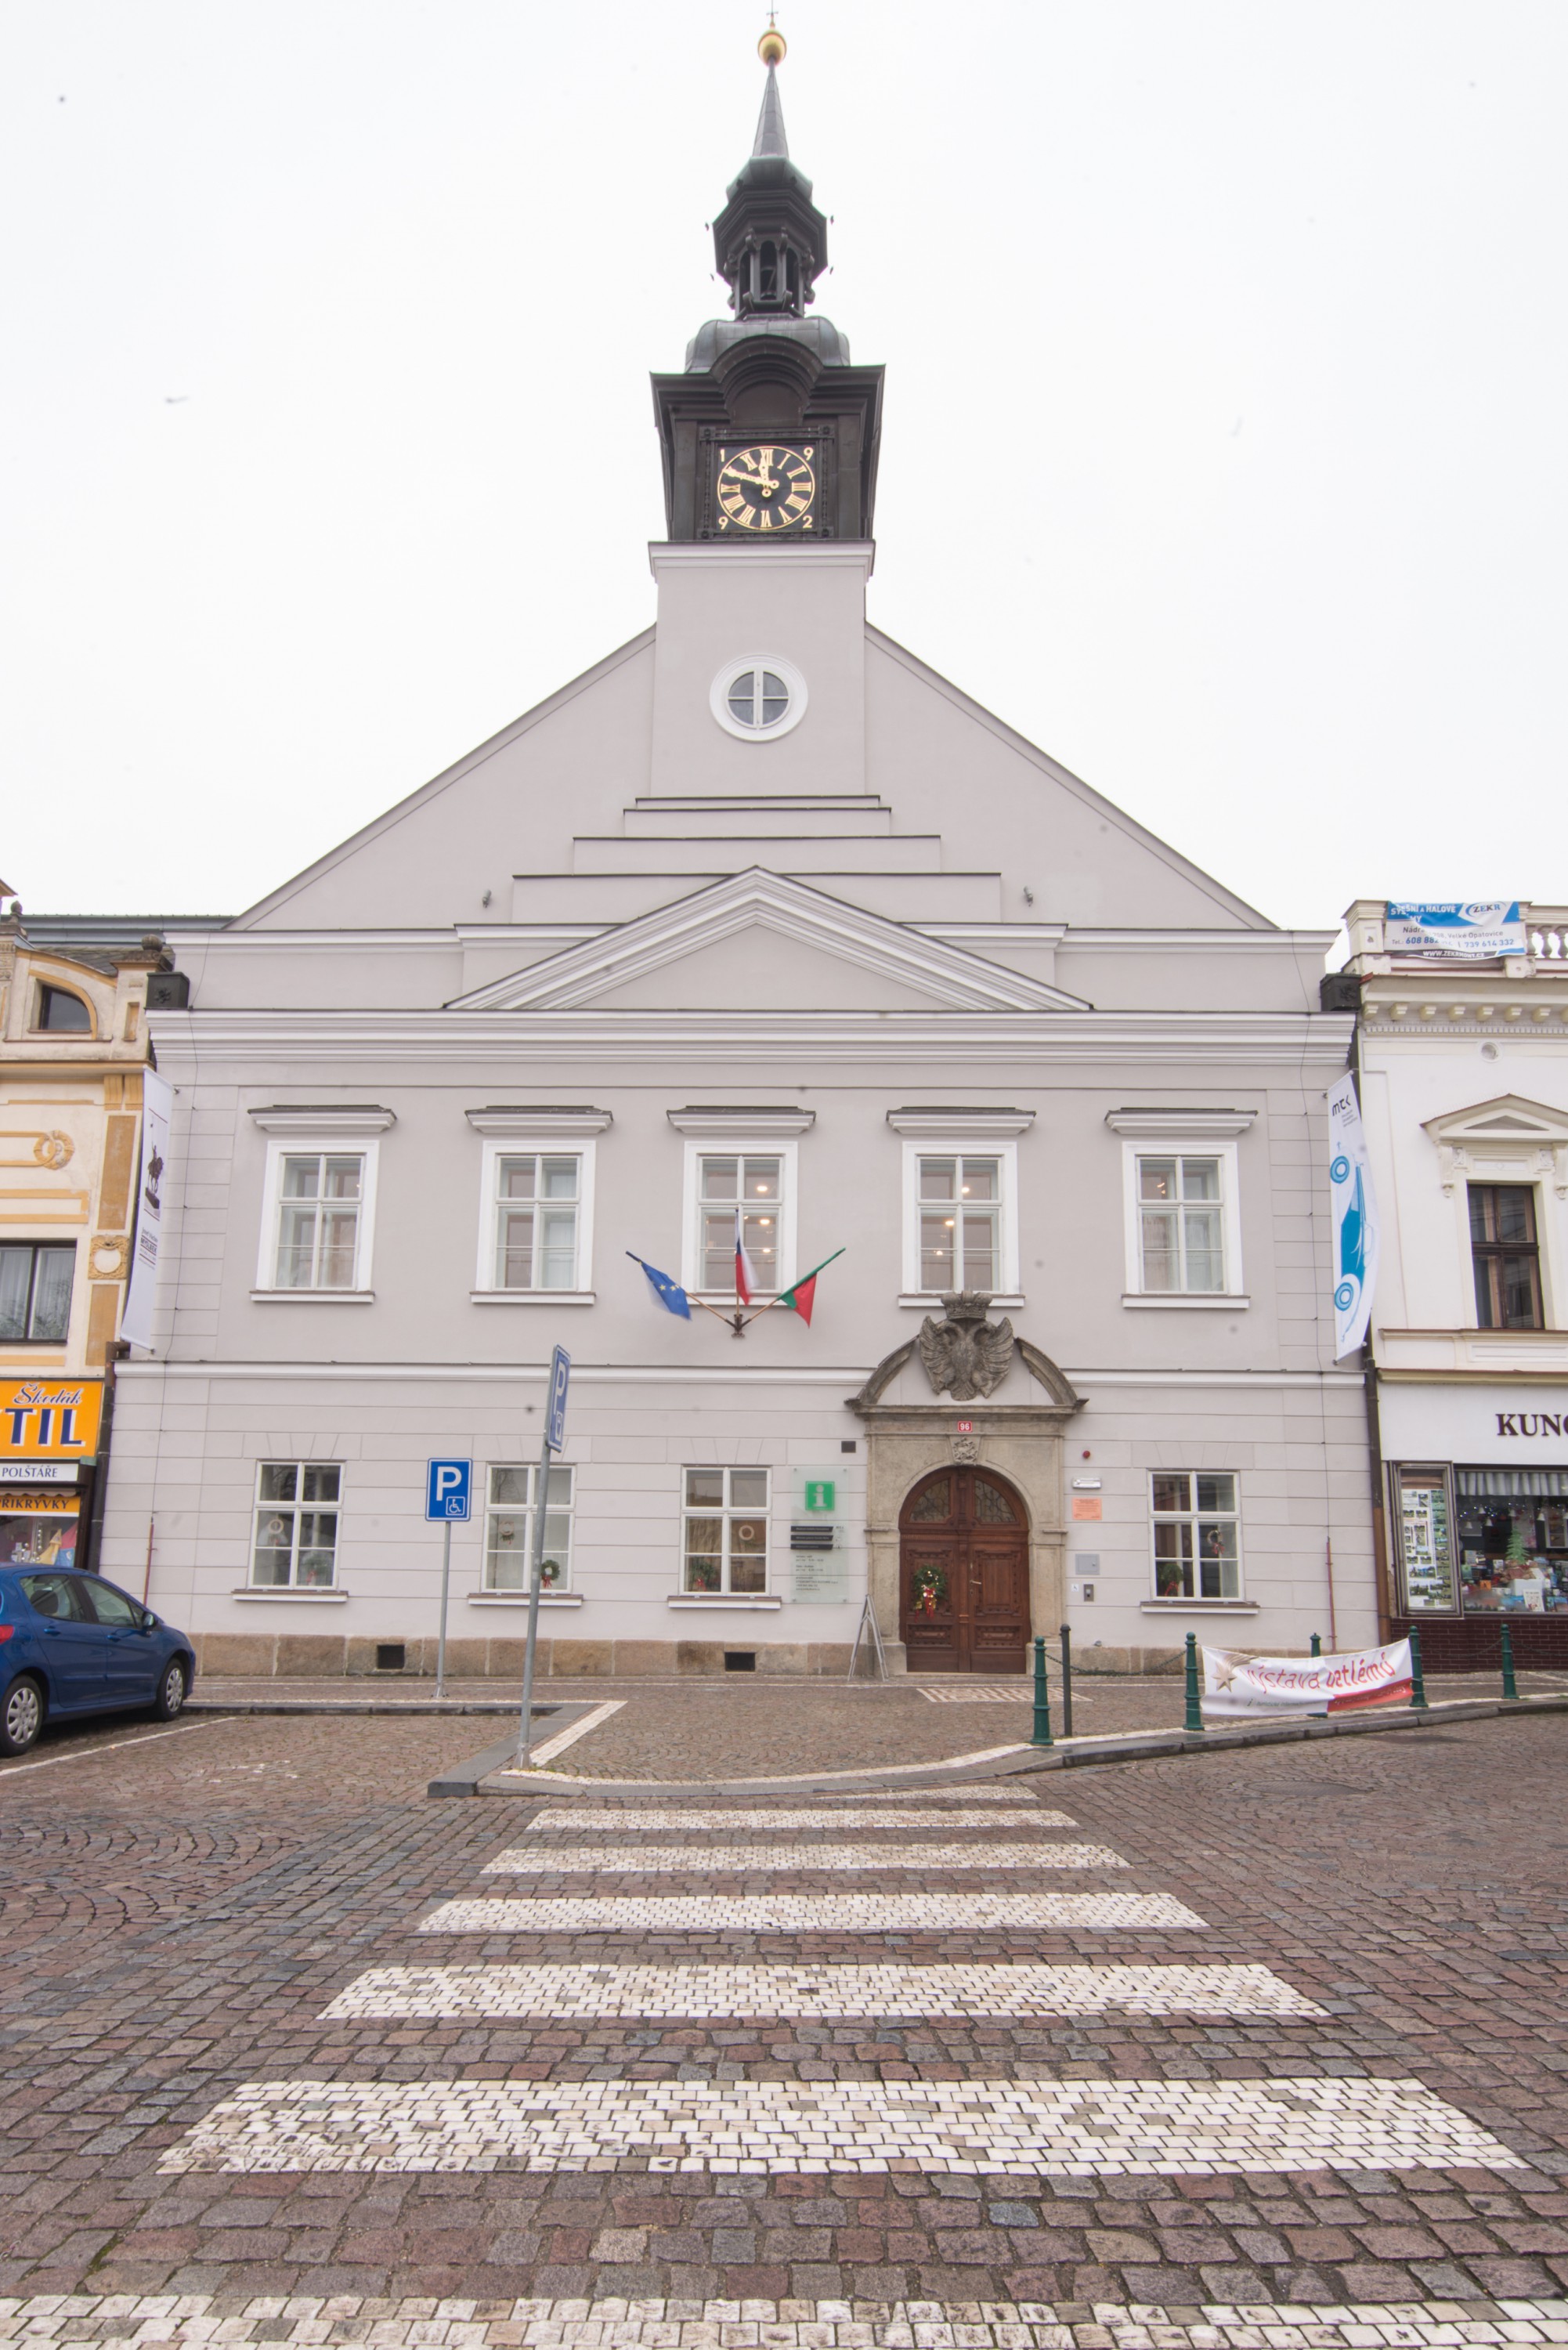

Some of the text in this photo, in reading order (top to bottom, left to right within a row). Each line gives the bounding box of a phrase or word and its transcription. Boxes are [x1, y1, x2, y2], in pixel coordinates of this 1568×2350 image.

[720, 449, 725, 462] 1
[804, 446, 814, 461] 9
[718, 516, 728, 530] 9
[803, 515, 812, 529] 2
[1473, 904, 1501, 913] ZEKR
[1469, 931, 1504, 940] Opatovice
[13, 1383, 82, 1405] Škodák
[554, 1361, 565, 1415] P
[4, 1408, 85, 1446] TIL
[2, 1464, 58, 1478] POLŠTÁŘE
[436, 1466, 462, 1501] P
[1241, 1665, 1320, 1694] Výstava
